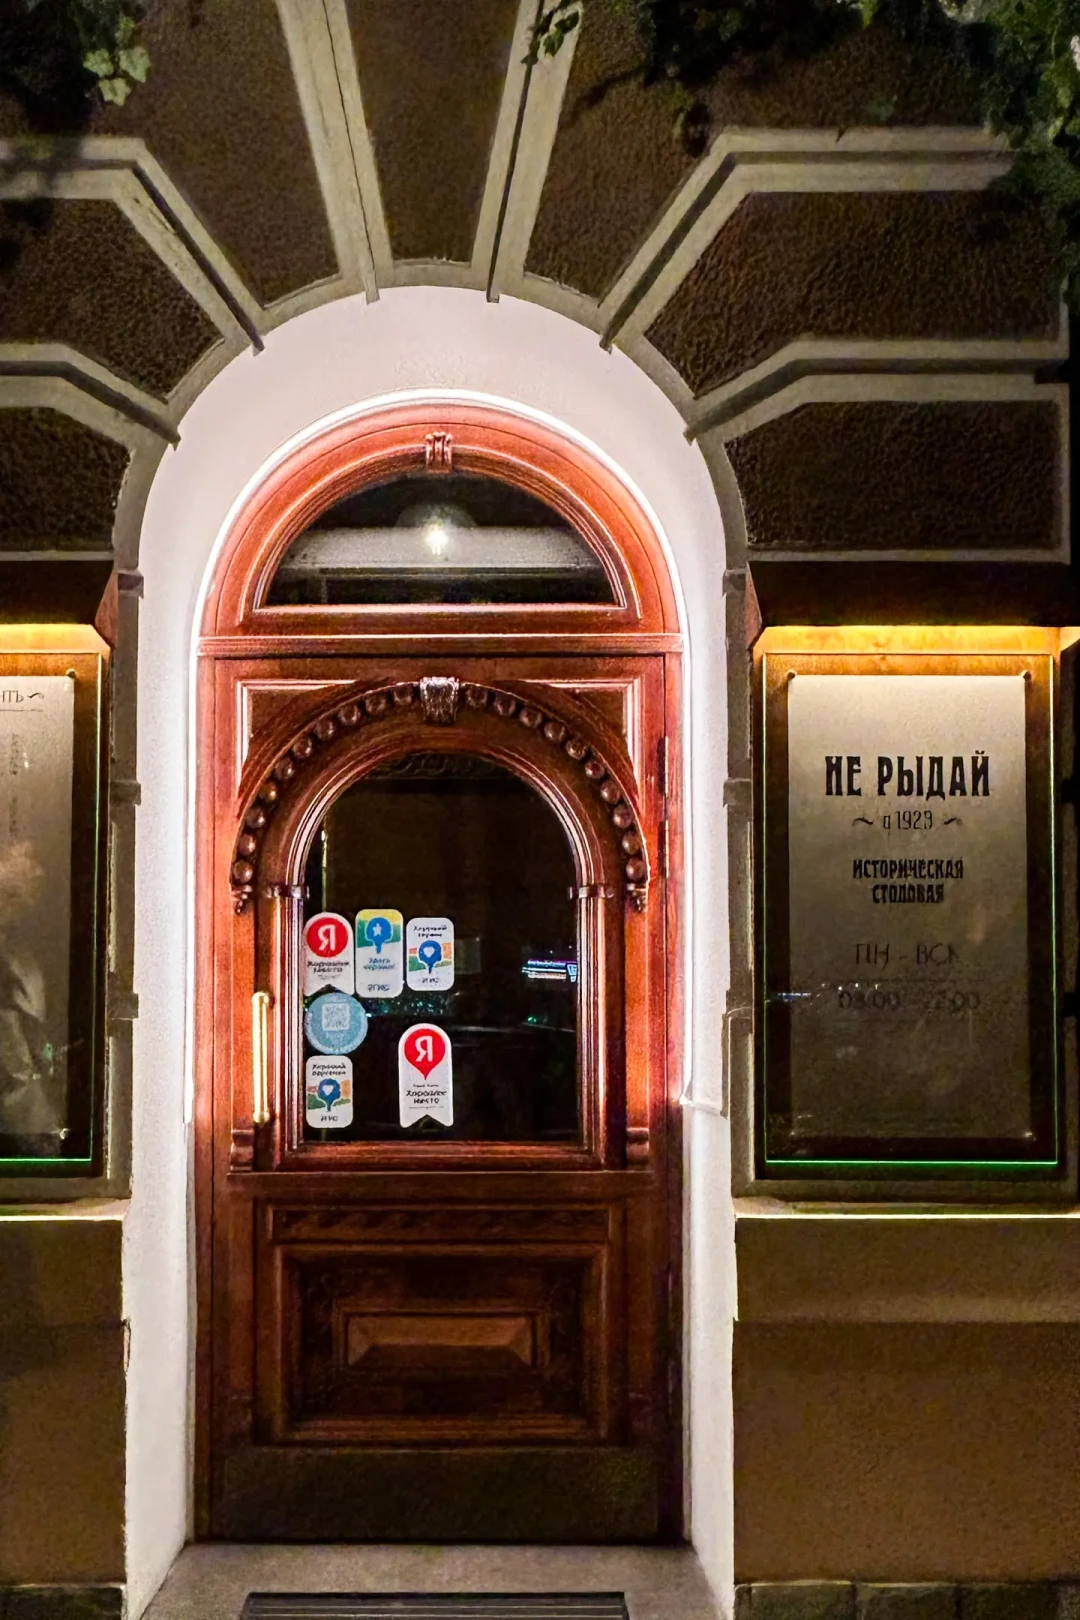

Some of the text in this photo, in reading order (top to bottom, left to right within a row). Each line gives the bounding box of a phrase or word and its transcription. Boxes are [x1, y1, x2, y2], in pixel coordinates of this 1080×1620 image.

[825, 750, 990, 801] НЕ РЫДАЙ
[853, 858, 964, 879] ИСТОРИЧЕСКАЯ
[872, 883, 945, 904] СТОЛОВАЯ
[317, 924, 336, 951] Я
[415, 1035, 433, 1063] Я
